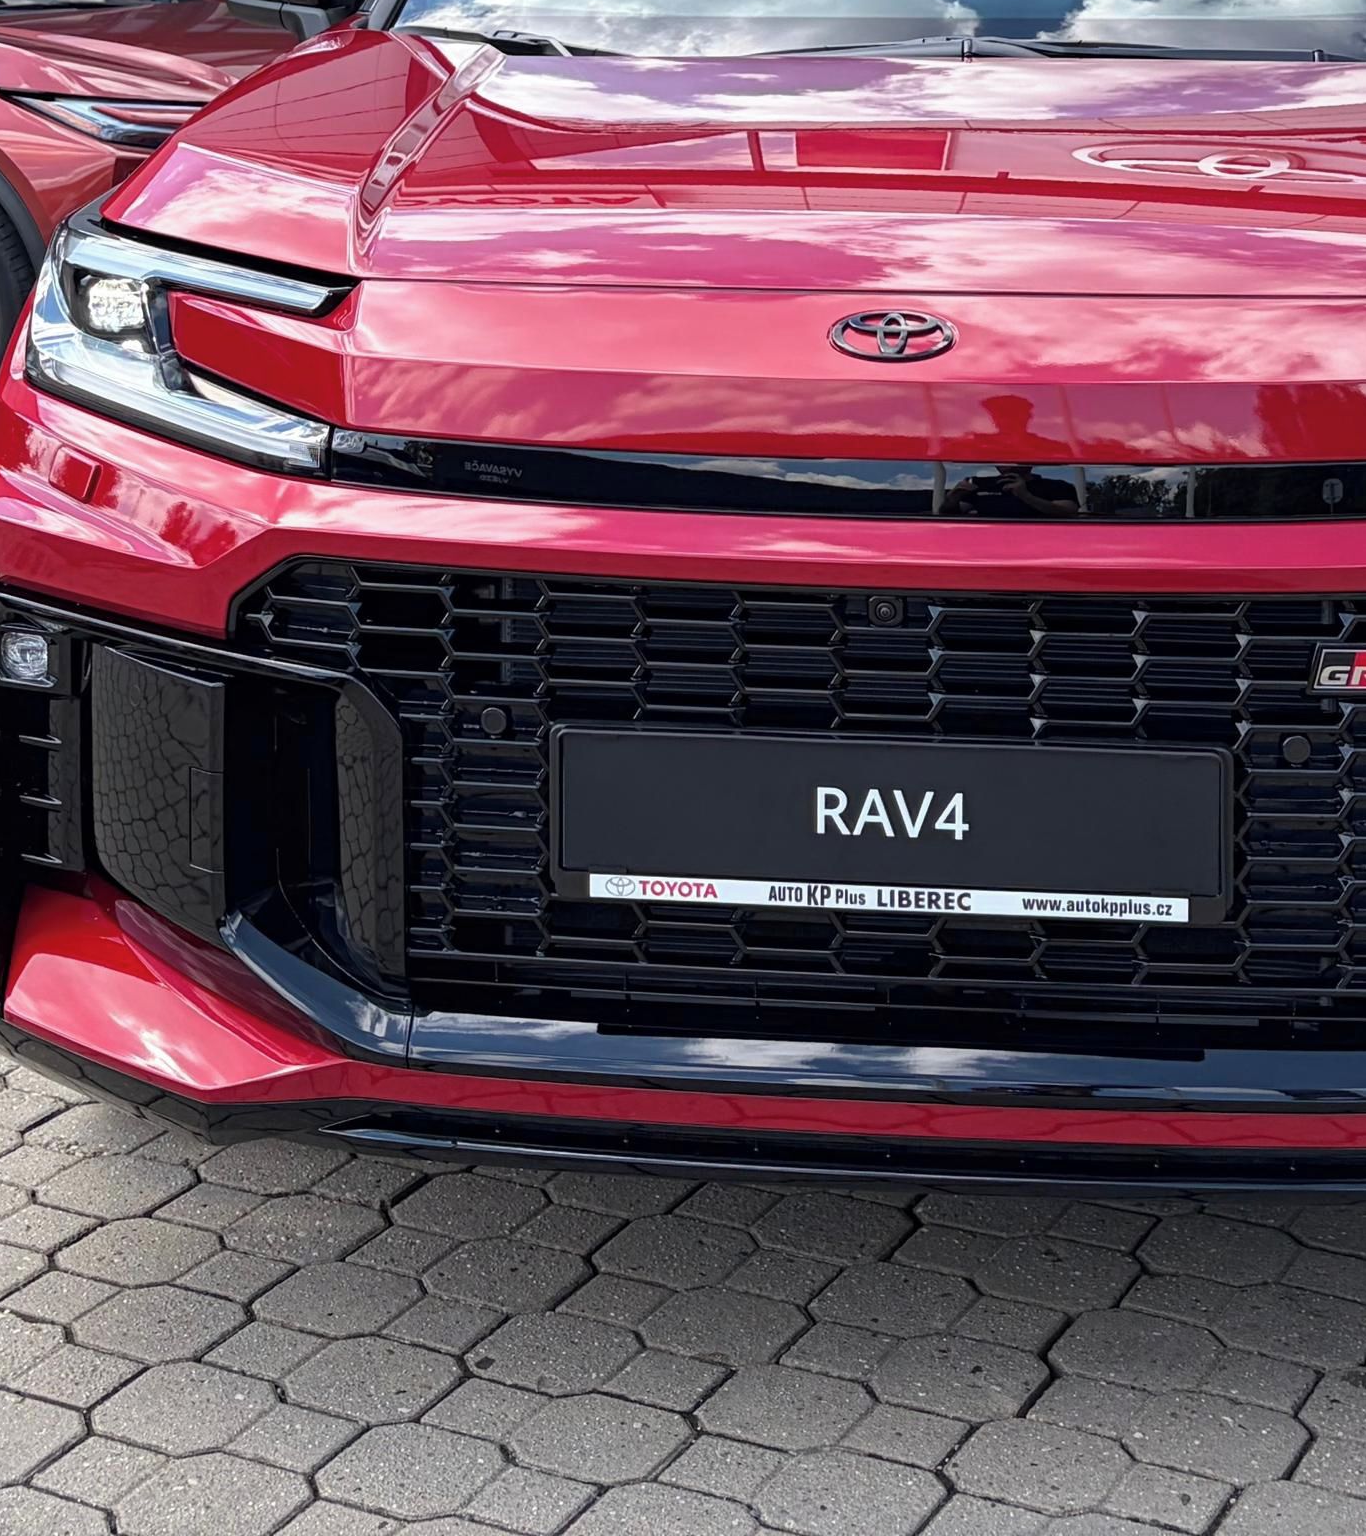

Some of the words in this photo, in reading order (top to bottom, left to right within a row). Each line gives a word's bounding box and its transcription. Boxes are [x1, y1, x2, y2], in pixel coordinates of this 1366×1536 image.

[816, 786, 969, 840] RAV4
[639, 879, 718, 898] TOYOTA
[768, 884, 803, 904] AUTO
[806, 884, 831, 908] KP
[835, 890, 866, 907] Plus
[877, 889, 972, 911] LIBEREC
[1022, 896, 1173, 918] www.autokpplus.cz
